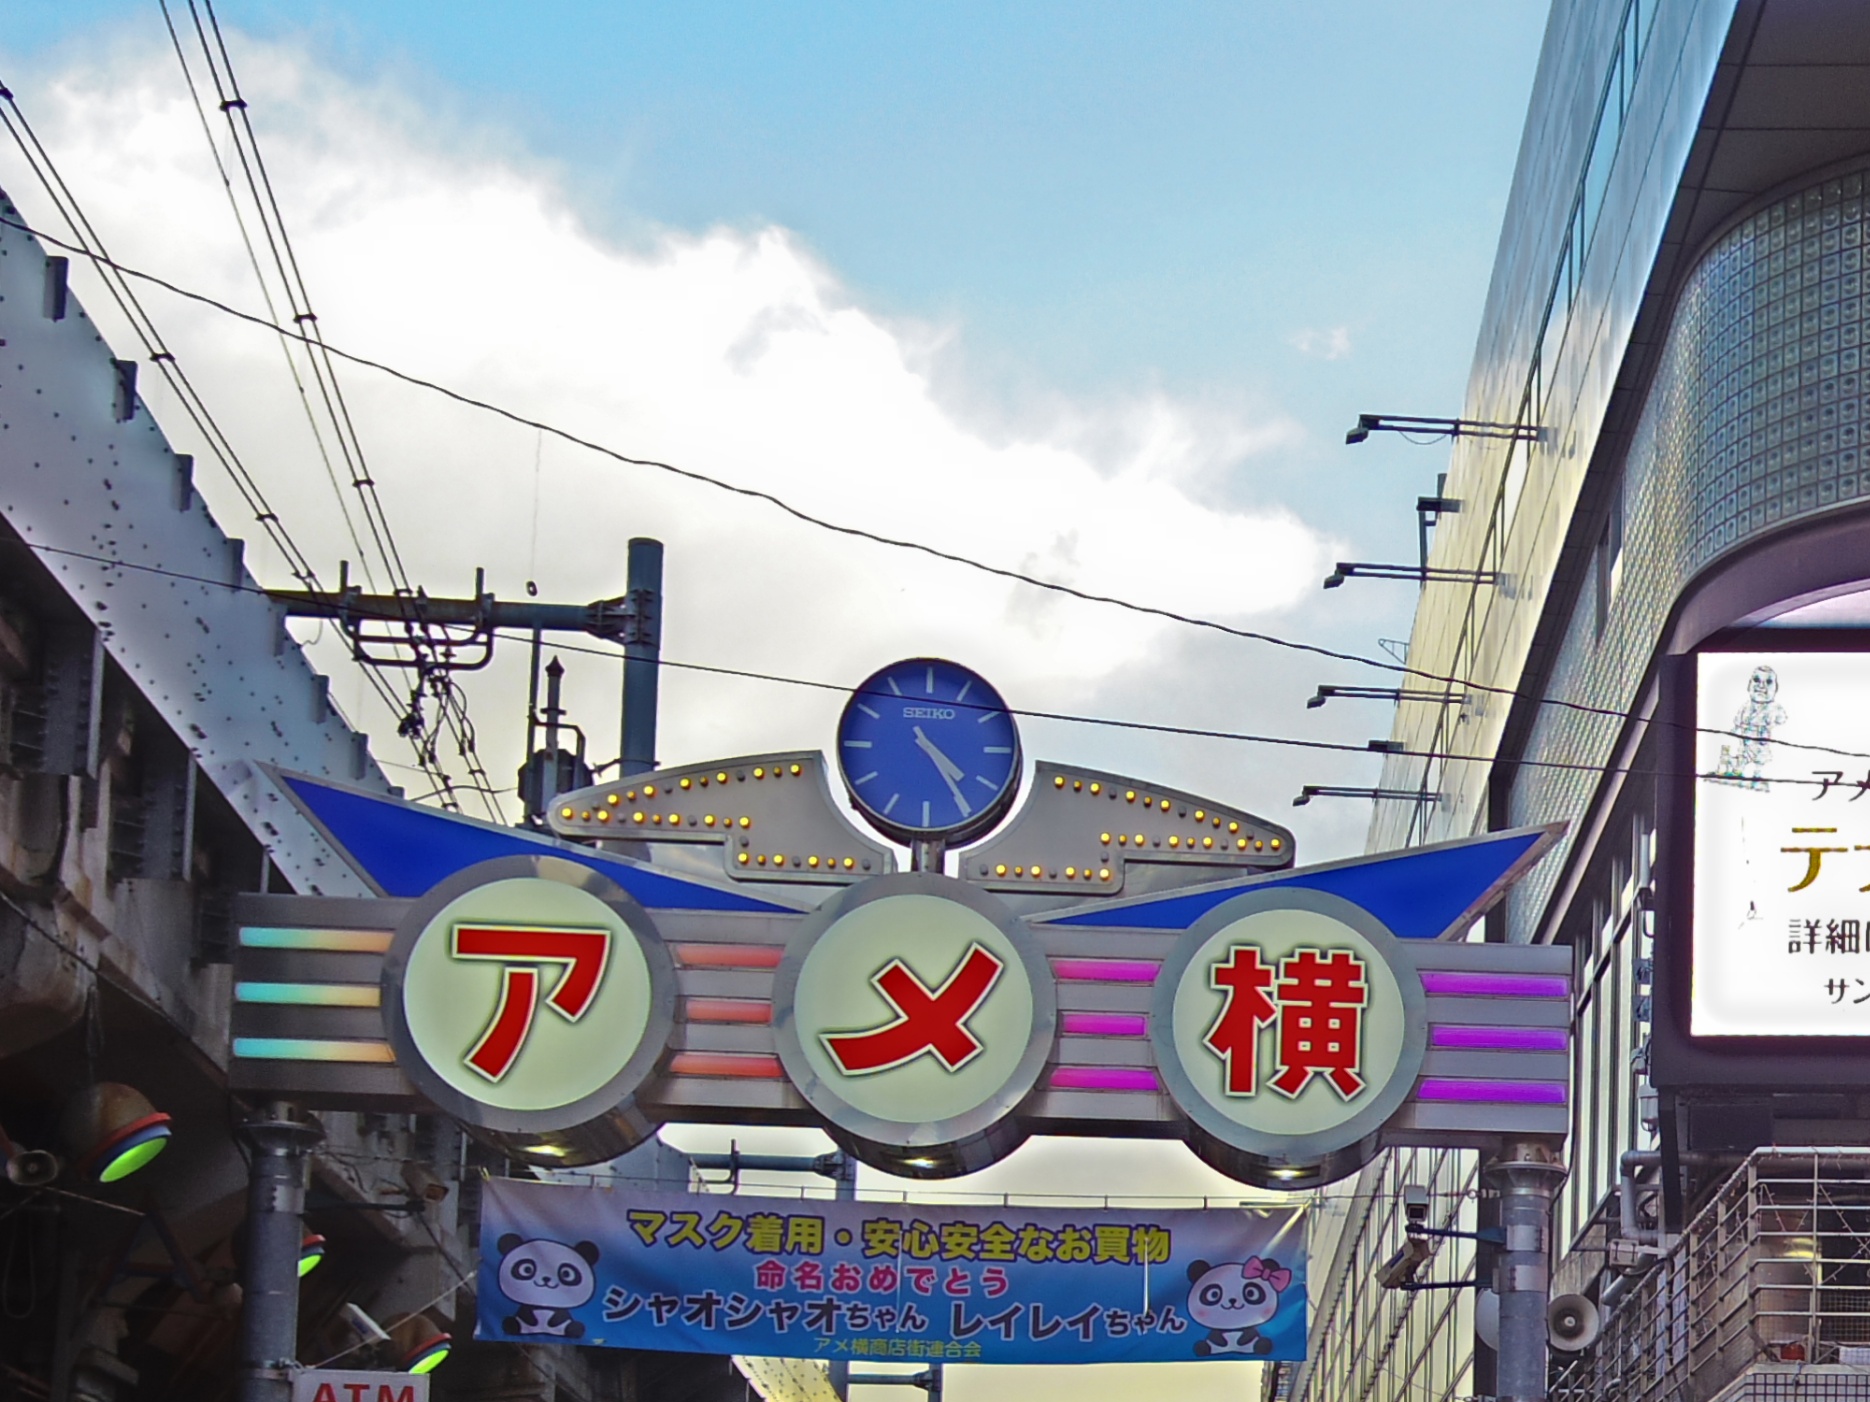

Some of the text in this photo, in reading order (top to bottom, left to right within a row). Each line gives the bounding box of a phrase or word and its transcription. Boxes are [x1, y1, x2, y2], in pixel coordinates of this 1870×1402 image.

[903, 707, 956, 720] SEIKO
[626, 1208, 1171, 1265] マスク着用・安心安全なお買物
[754, 1263, 1010, 1296] 命名おめでとう
[601, 1285, 1187, 1337] シャオシャオちゃん レイレイちゃん
[812, 1336, 982, 1359] アメ横商店街連合会
